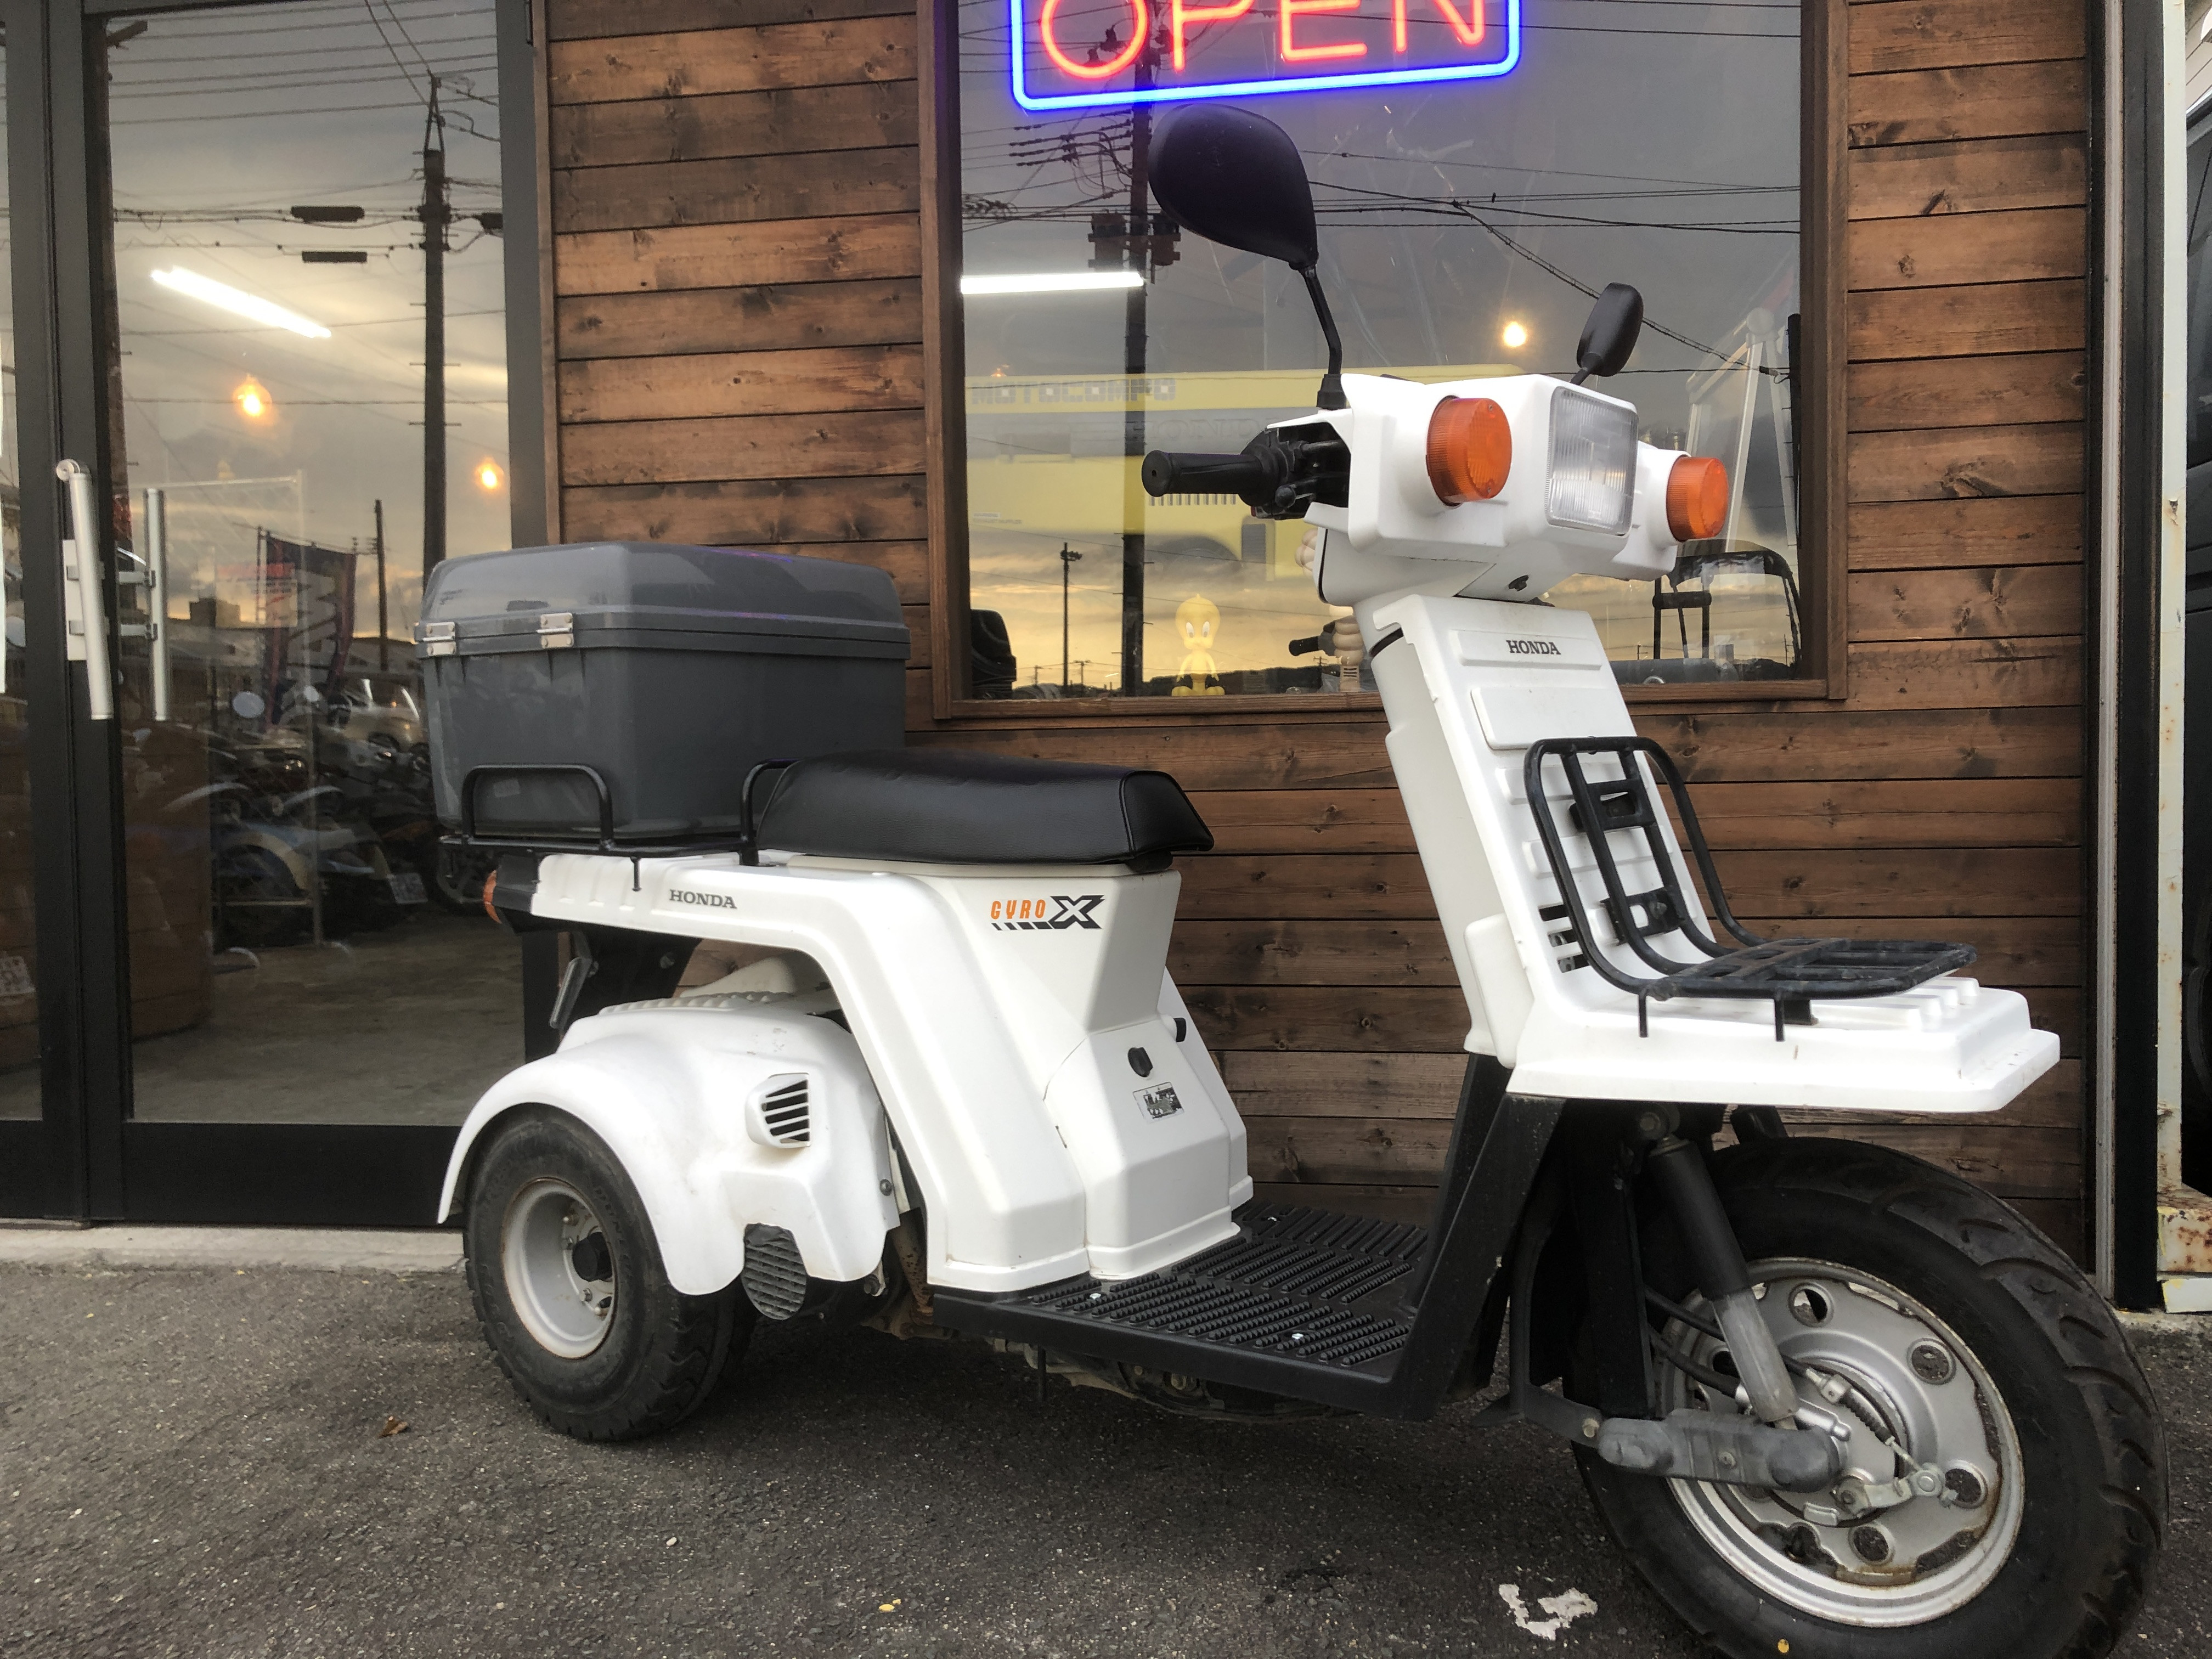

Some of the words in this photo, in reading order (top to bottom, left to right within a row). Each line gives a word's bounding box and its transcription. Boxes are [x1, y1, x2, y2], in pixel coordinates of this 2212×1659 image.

[1506, 640, 1561, 654] HONDA
[669, 889, 738, 909] HONDA
[991, 899, 1046, 919] GYRO
[1048, 895, 1105, 929] X
